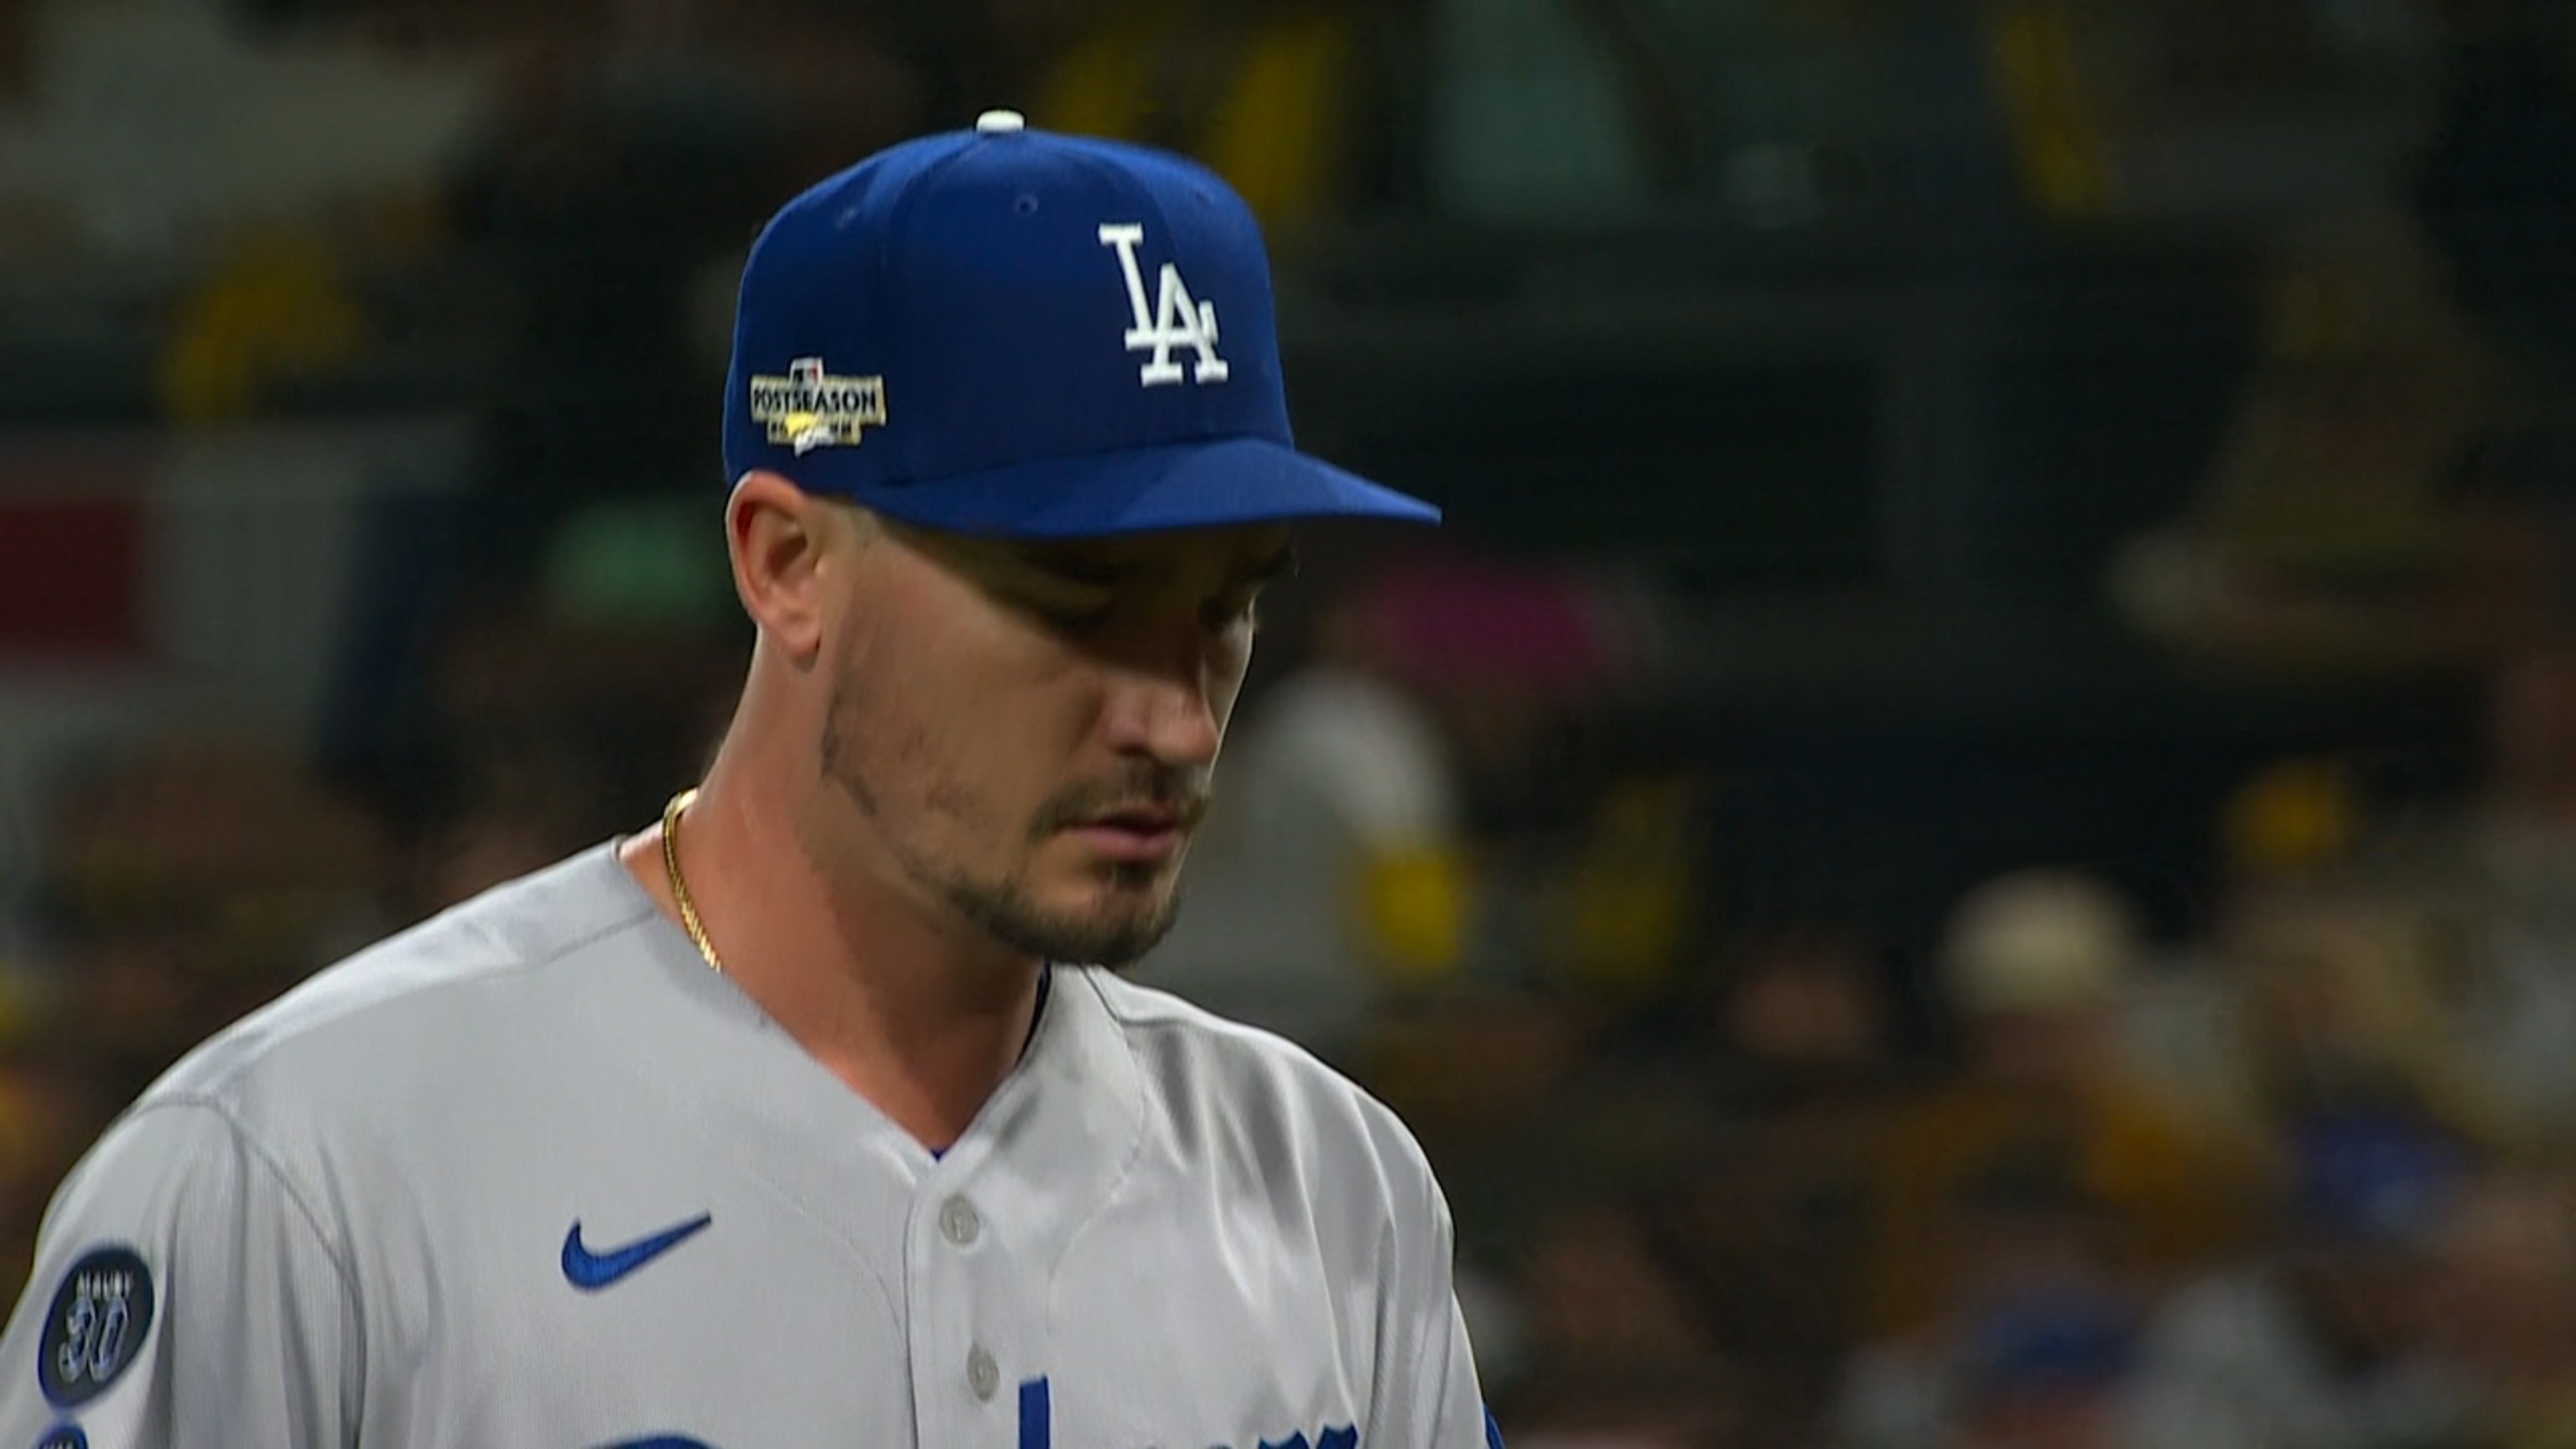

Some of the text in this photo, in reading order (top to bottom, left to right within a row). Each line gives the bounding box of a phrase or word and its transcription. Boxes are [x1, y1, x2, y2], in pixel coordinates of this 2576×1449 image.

[1098, 223, 1228, 386] LA
[752, 385, 877, 415] POSTSEASON
[58, 1292, 129, 1382] 30
